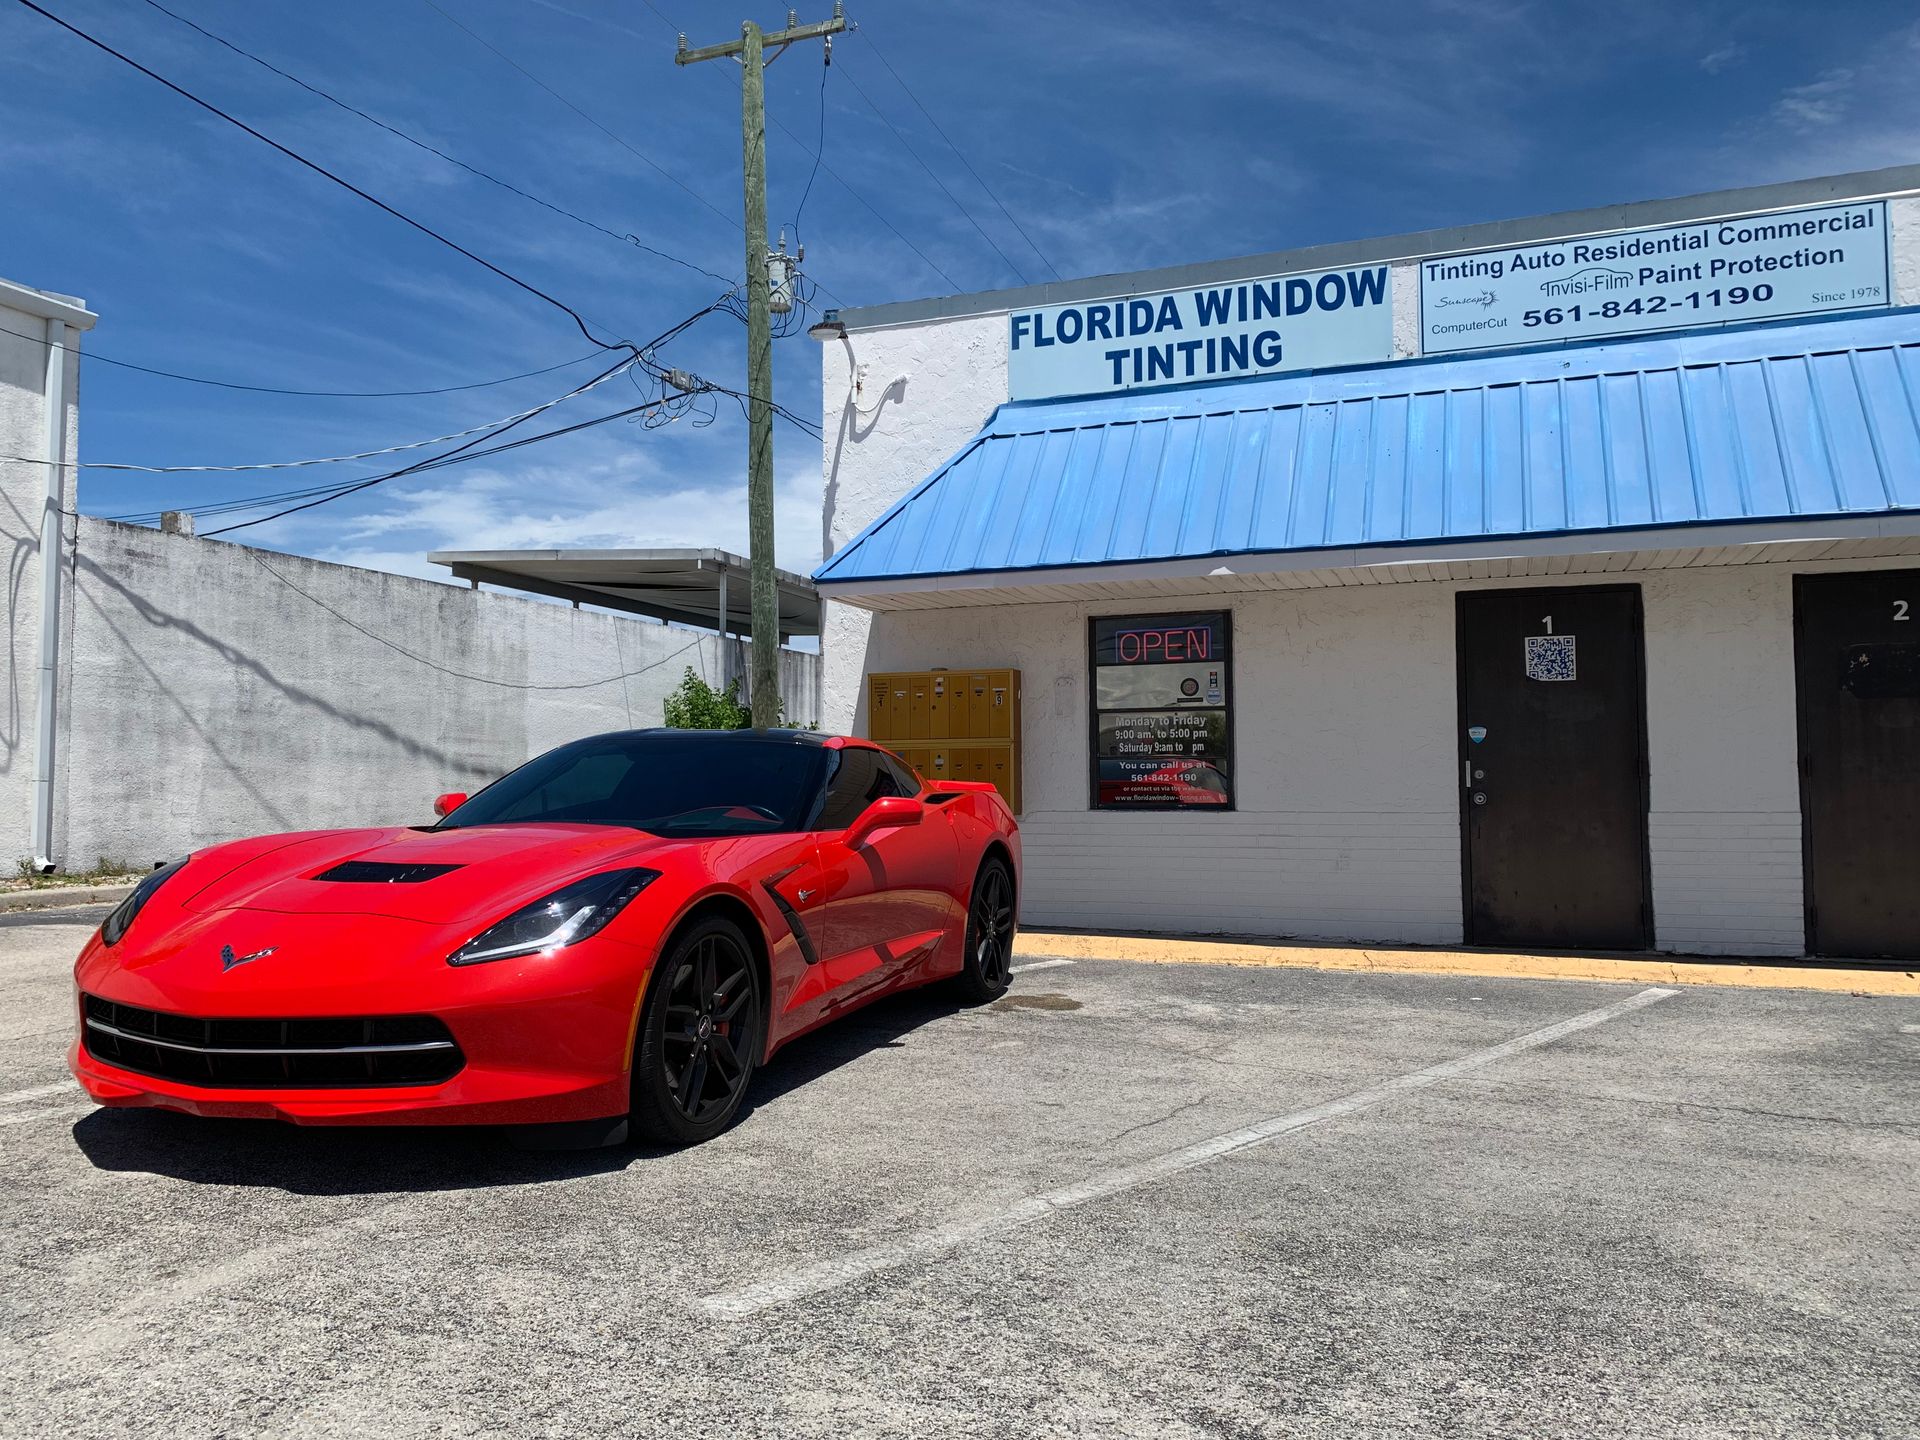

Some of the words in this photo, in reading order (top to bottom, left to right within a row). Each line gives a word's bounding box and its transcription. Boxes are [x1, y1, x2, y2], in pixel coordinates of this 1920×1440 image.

[1426, 259, 1503, 281] Tinting
[1510, 251, 1566, 272] Auto
[1574, 230, 1709, 264] Residential
[1718, 208, 1874, 246] Commercial
[1639, 262, 1702, 286] Paint
[1711, 248, 1844, 278] Protection
[1544, 272, 1630, 297] Invisi-Film
[1522, 283, 1774, 327] 561-842-1190
[1812, 291, 1846, 304] Since
[1851, 286, 1881, 299] 1978
[1011, 296, 1182, 350] FLORIDA
[1194, 267, 1388, 327] WINDOW
[1431, 317, 1507, 335] ComputerCut
[1105, 330, 1282, 385] TINTING
[1893, 600, 1910, 621] 2
[1541, 615, 1553, 634] 1
[1120, 629, 1207, 662] OPEN
[1115, 716, 1157, 727] Monday
[1159, 717, 1170, 726] to
[1173, 715, 1207, 727] Friday
[1115, 730, 1135, 740] 9:00
[1157, 729, 1167, 738] to
[1170, 728, 1190, 738] 5:00
[1192, 730, 1208, 740] pm
[1119, 742, 1153, 754] Saturday
[1154, 743, 1173, 752] 9:am
[1175, 743, 1184, 752] to
[1192, 743, 1205, 754] pm
[1119, 761, 1137, 769] You
[1160, 760, 1178, 769] call
[1195, 761, 1206, 769] at
[1131, 774, 1197, 782] 561-842-1190
